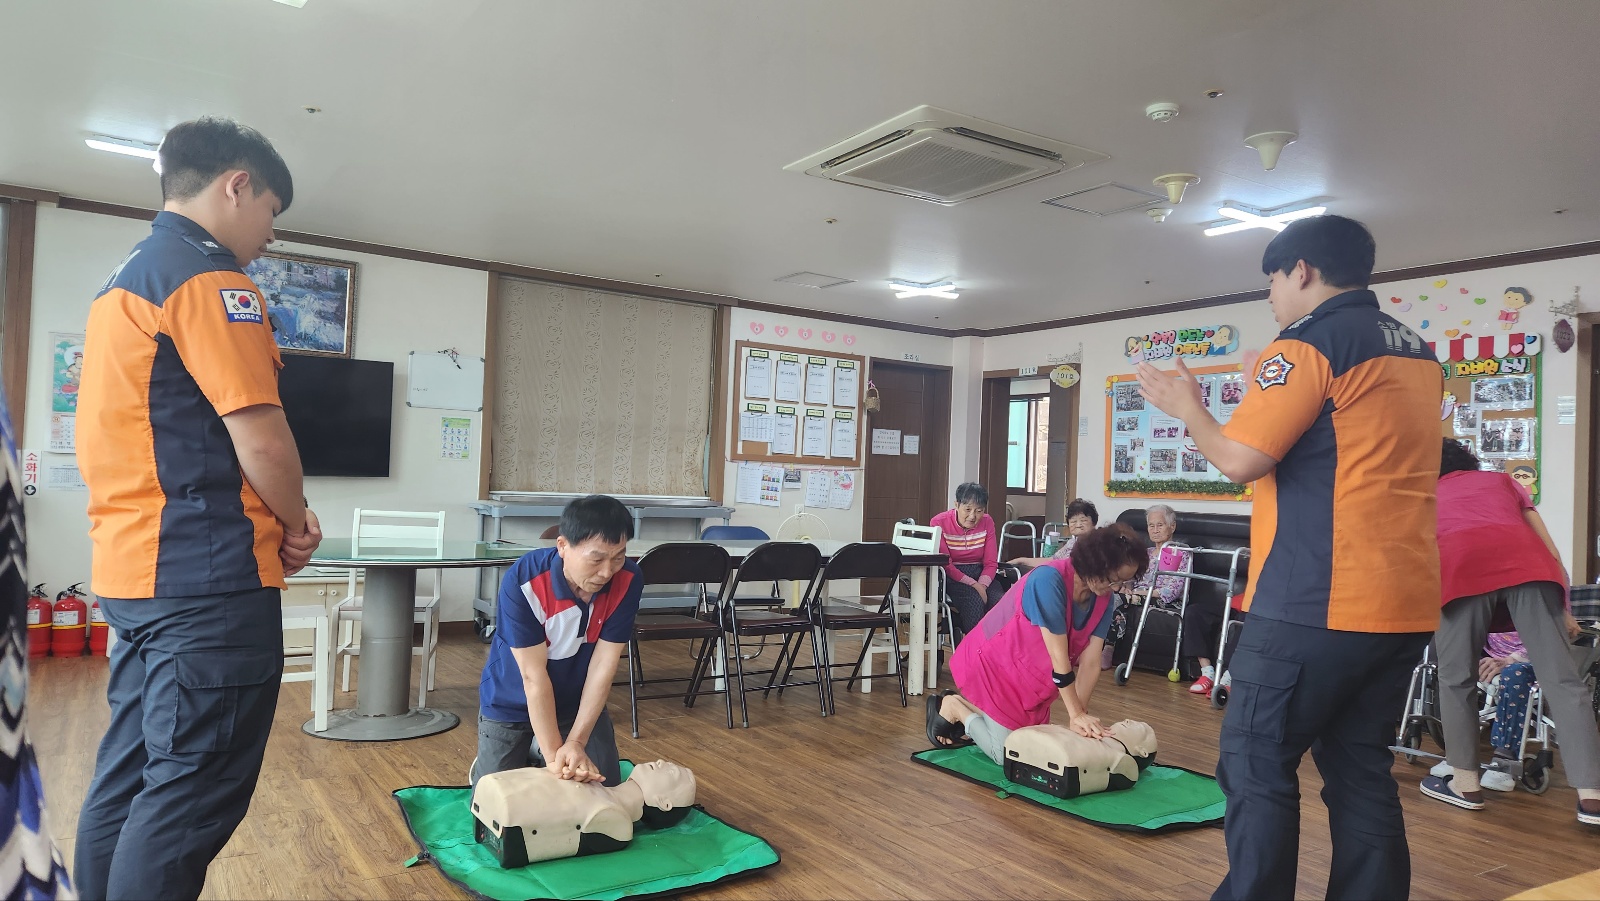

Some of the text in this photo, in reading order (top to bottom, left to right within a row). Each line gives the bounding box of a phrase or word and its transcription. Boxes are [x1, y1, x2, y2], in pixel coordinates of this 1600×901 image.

[234, 313, 261, 321] KOREA
[1382, 324, 1421, 354] 119
[1456, 358, 1527, 376] 자비원 소식
[24, 452, 38, 484] 소화기
